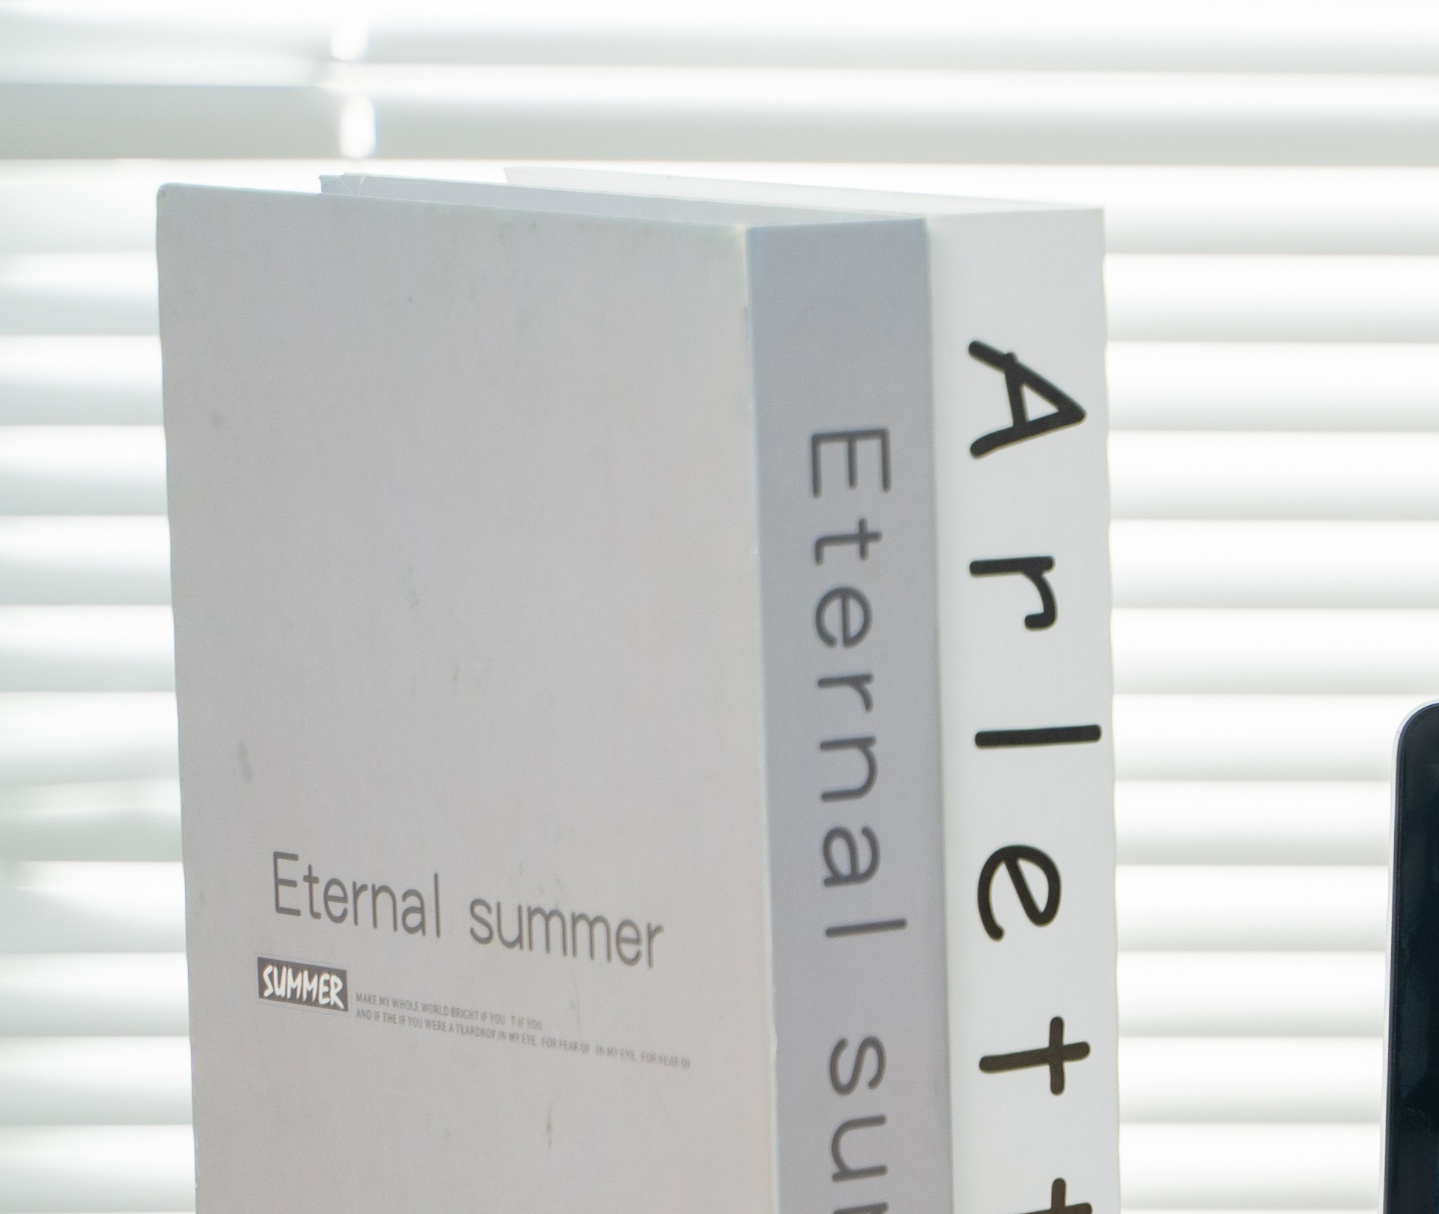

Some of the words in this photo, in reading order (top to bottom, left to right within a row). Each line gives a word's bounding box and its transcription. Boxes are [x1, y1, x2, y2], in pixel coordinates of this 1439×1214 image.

[810, 427, 908, 939] Eternal
[271, 850, 443, 939] Eternal
[469, 897, 665, 971] summer
[262, 964, 345, 1010] SUMMER
[355, 992, 377, 1006] MAKE
